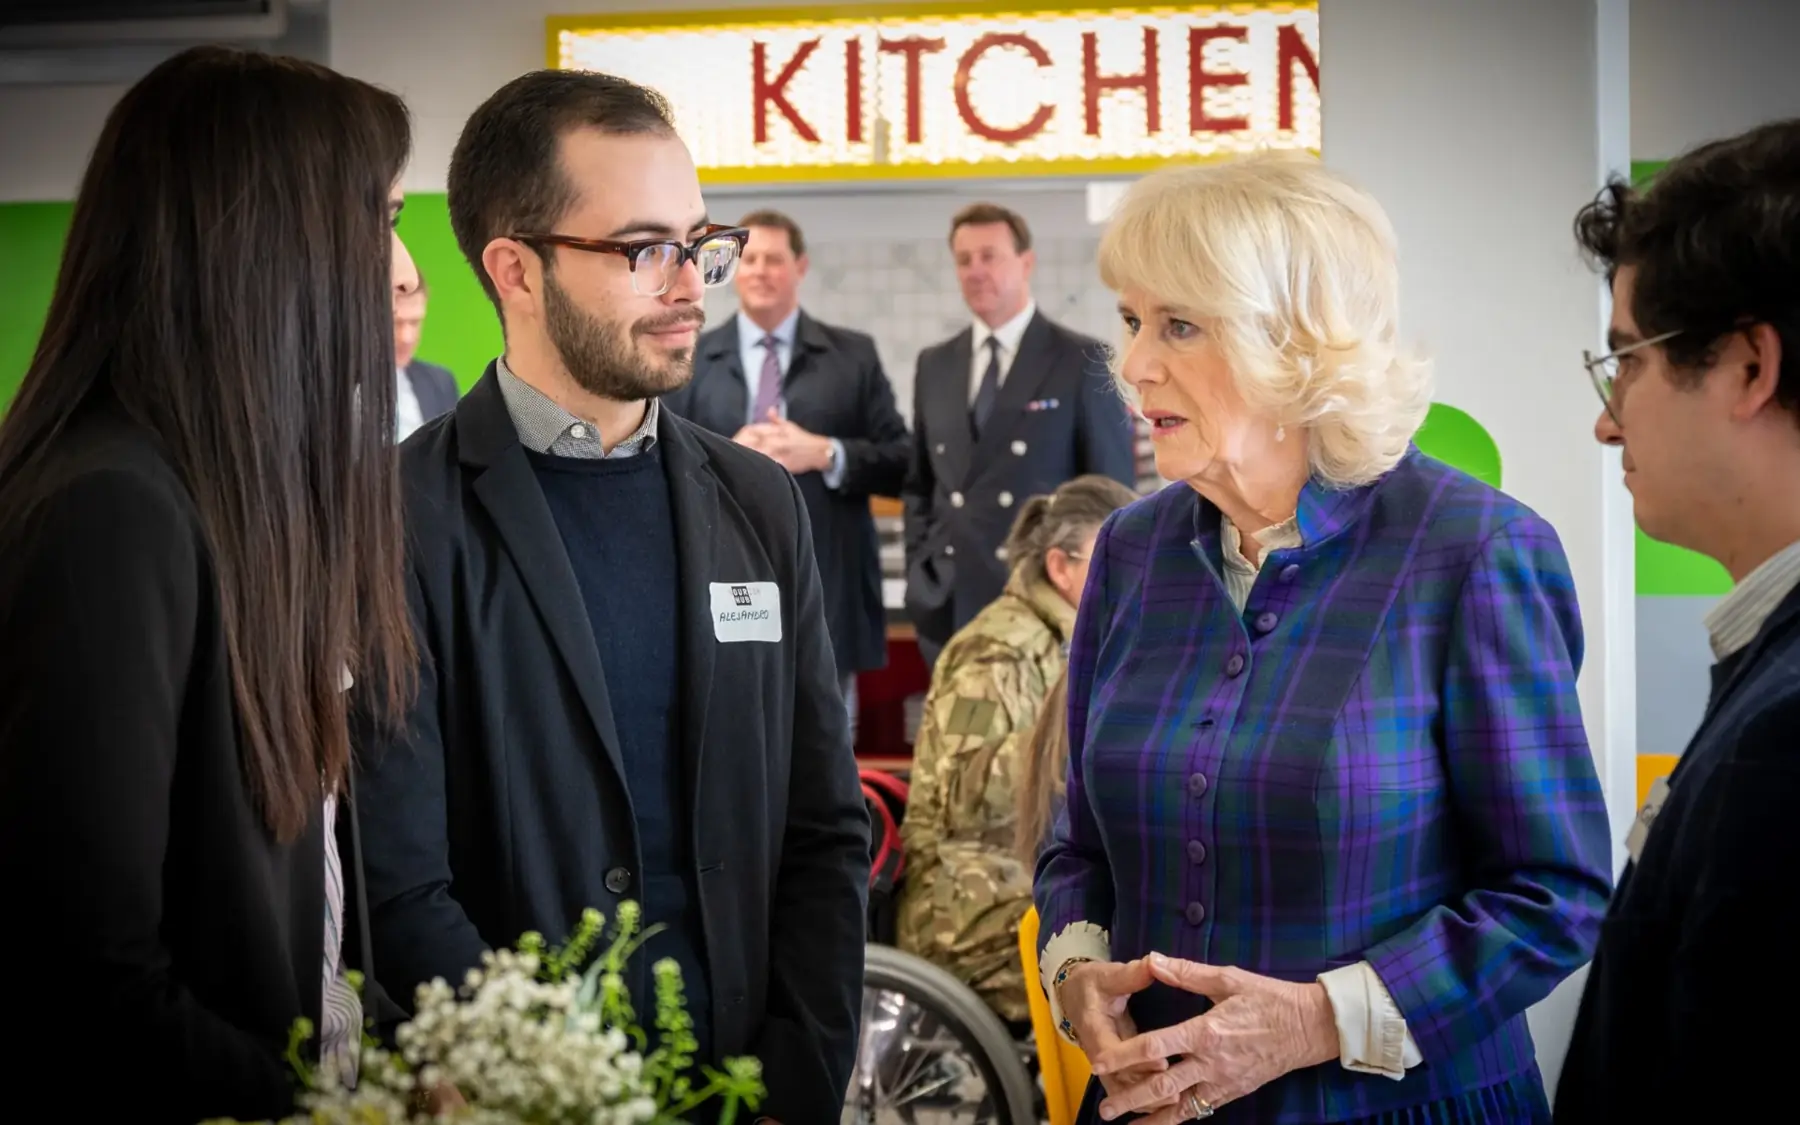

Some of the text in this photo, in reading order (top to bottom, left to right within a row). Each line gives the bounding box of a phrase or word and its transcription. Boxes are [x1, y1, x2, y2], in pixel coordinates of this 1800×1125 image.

[732, 588, 748, 596] OUR
[735, 596, 751, 604] HUB
[719, 610, 769, 622] ALEJANDRO
